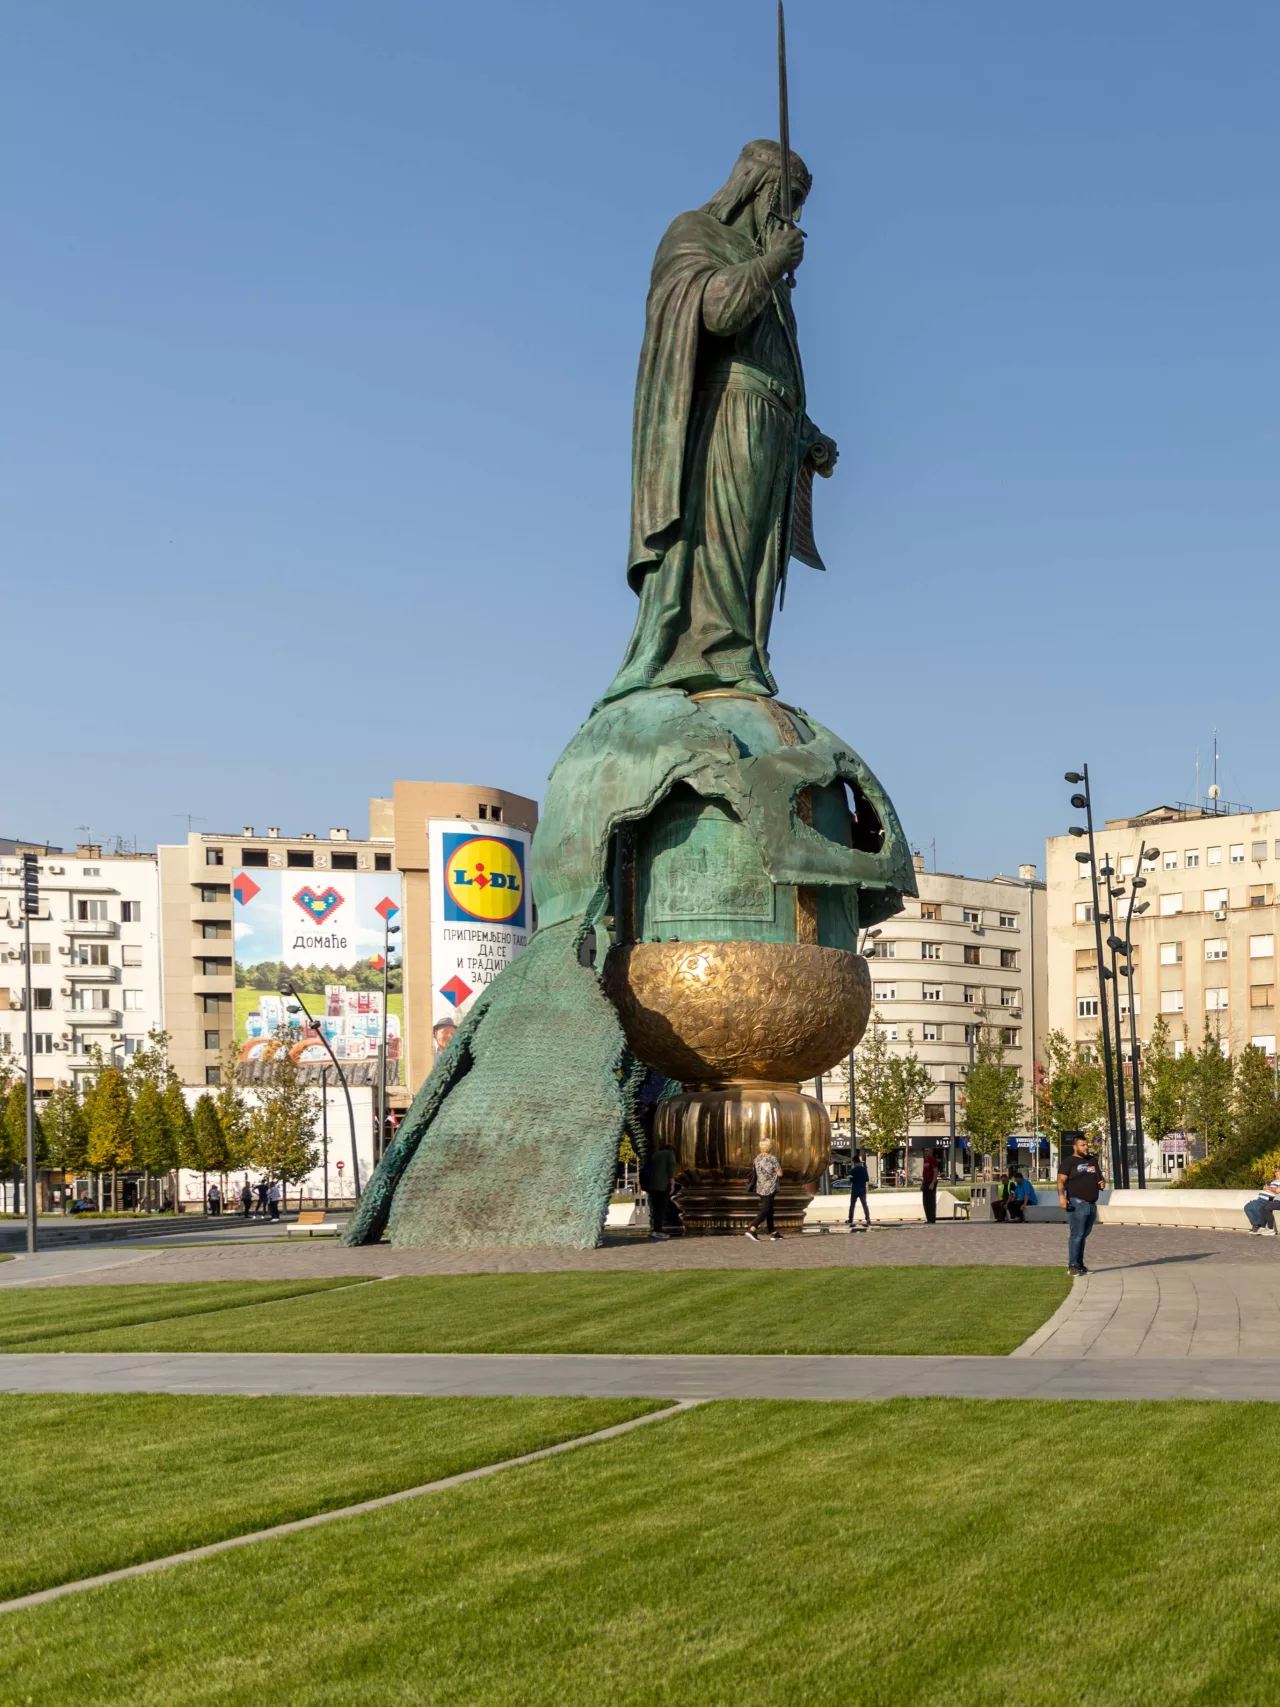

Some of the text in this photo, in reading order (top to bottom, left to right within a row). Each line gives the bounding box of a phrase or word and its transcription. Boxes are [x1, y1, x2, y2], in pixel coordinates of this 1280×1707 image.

[269, 853, 283, 867] 3
[314, 854, 328, 868] 8
[443, 928, 511, 944] ПРИПРЕМЉЕНО
[477, 944, 506, 957] ДА СЕ
[456, 957, 510, 971] И ТРАДИЦ
